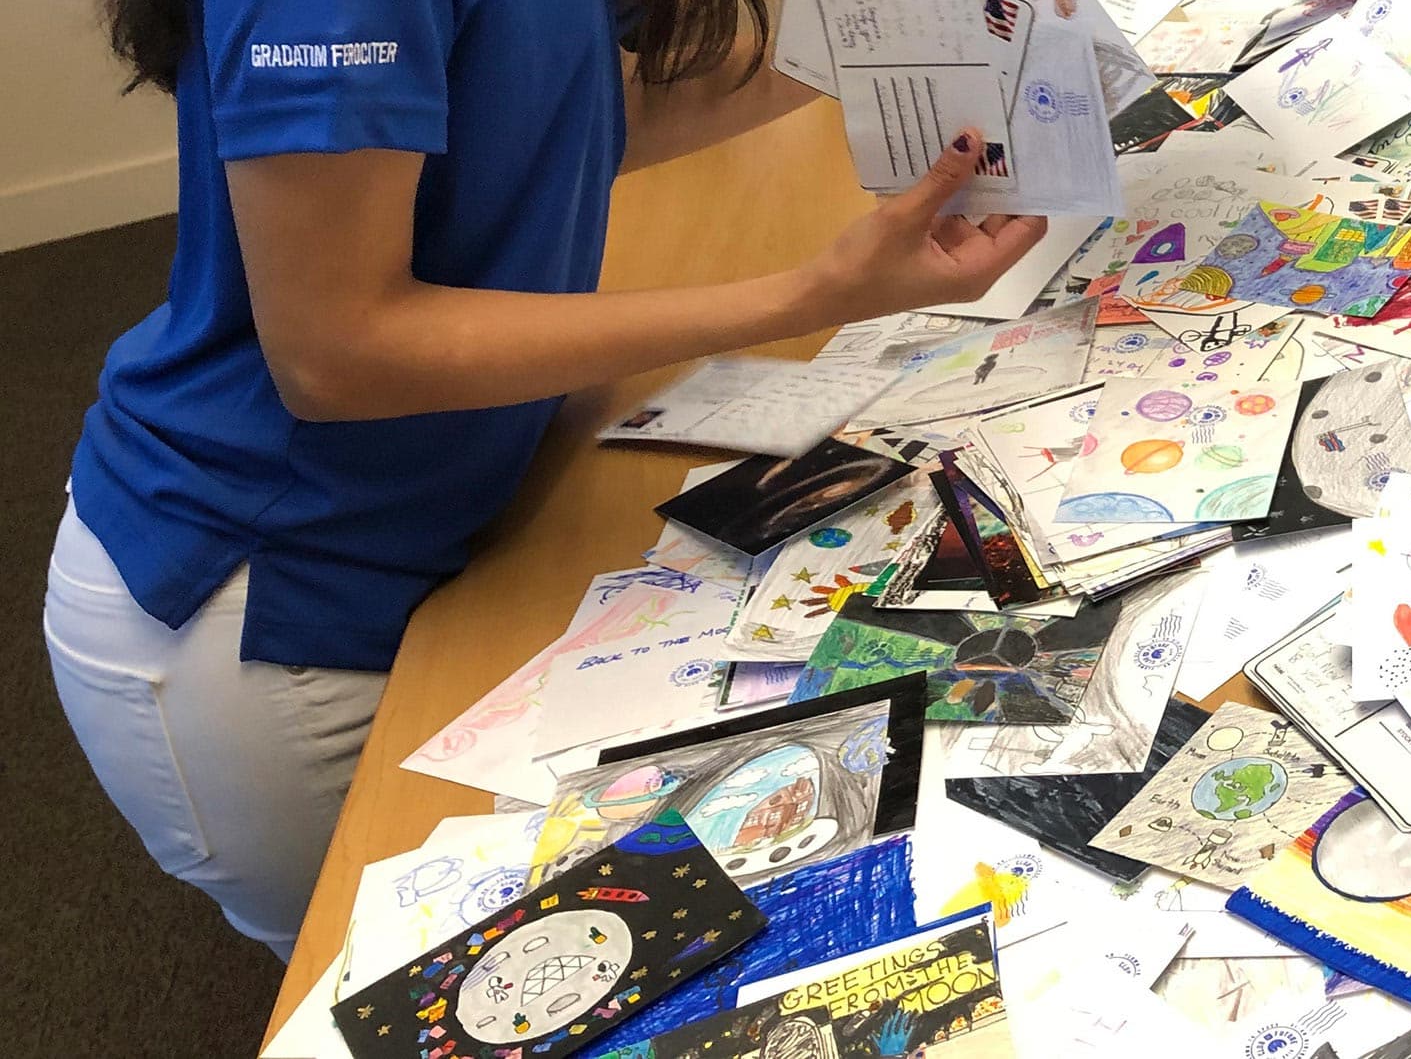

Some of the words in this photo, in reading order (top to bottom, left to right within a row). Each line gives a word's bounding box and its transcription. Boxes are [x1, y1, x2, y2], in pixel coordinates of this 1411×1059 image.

[251, 44, 327, 67] GRADATIM
[331, 41, 399, 67] FEROCITER
[576, 653, 624, 670] BACK
[630, 646, 650, 656] TO
[658, 636, 692, 648] THE
[1149, 793, 1182, 809] Earth
[782, 942, 946, 1011] GREETINGS
[829, 975, 909, 1019] FROM
[914, 955, 971, 987] THE
[901, 968, 998, 1014] MOON
